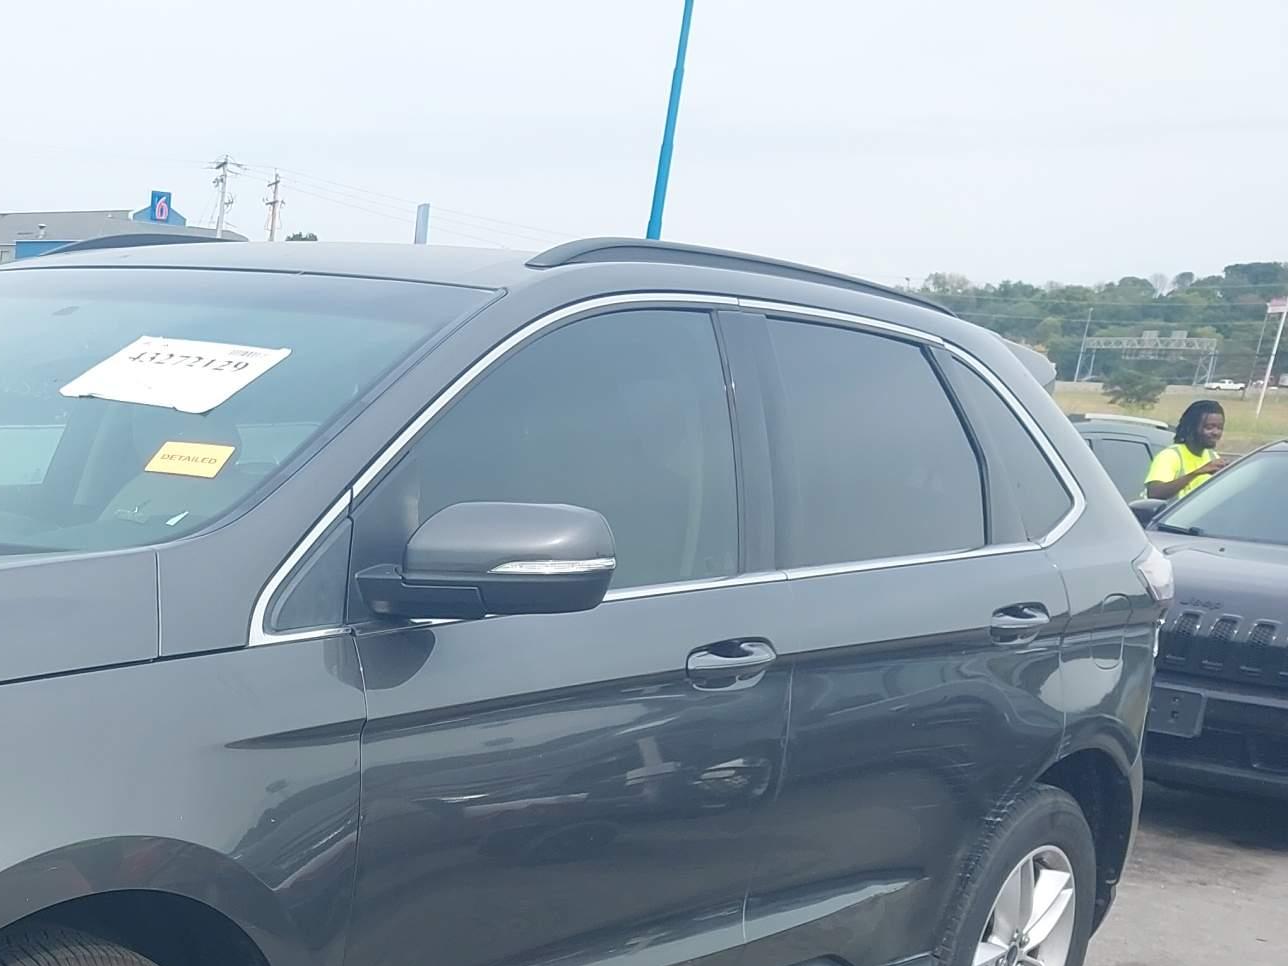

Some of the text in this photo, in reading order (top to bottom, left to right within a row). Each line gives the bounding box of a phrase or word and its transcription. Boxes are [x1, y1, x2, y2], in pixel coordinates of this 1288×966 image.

[155, 196, 169, 219] 6
[128, 351, 249, 372] 43272129
[160, 454, 217, 465] DETAILED
